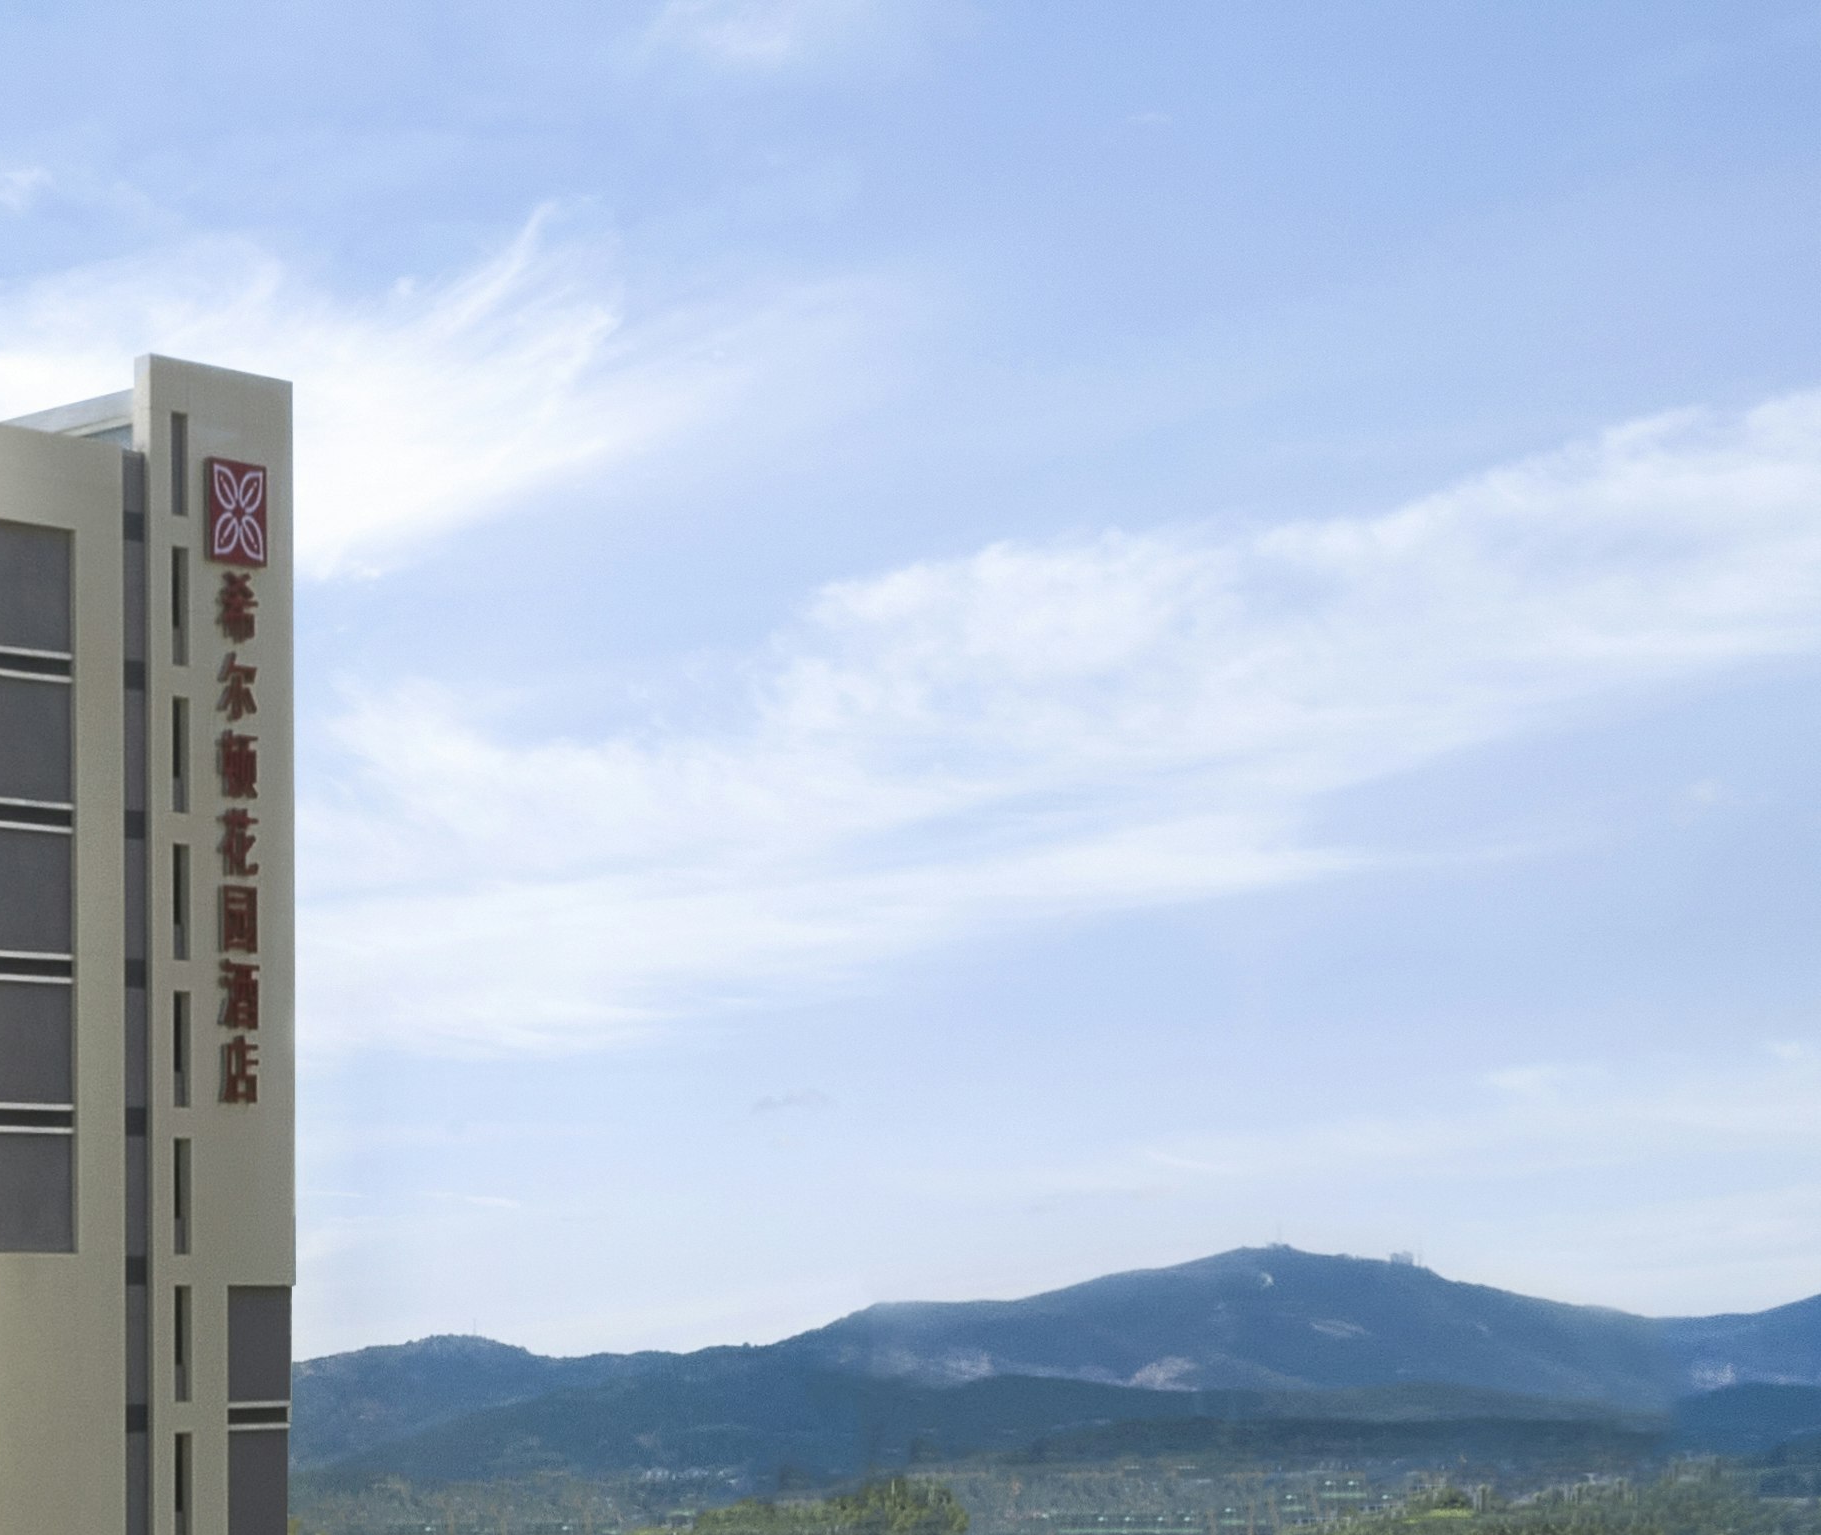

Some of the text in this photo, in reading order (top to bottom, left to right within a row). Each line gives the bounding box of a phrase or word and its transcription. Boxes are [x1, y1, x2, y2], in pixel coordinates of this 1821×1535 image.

[215, 571, 259, 1106] 希尔顿花园酒店
